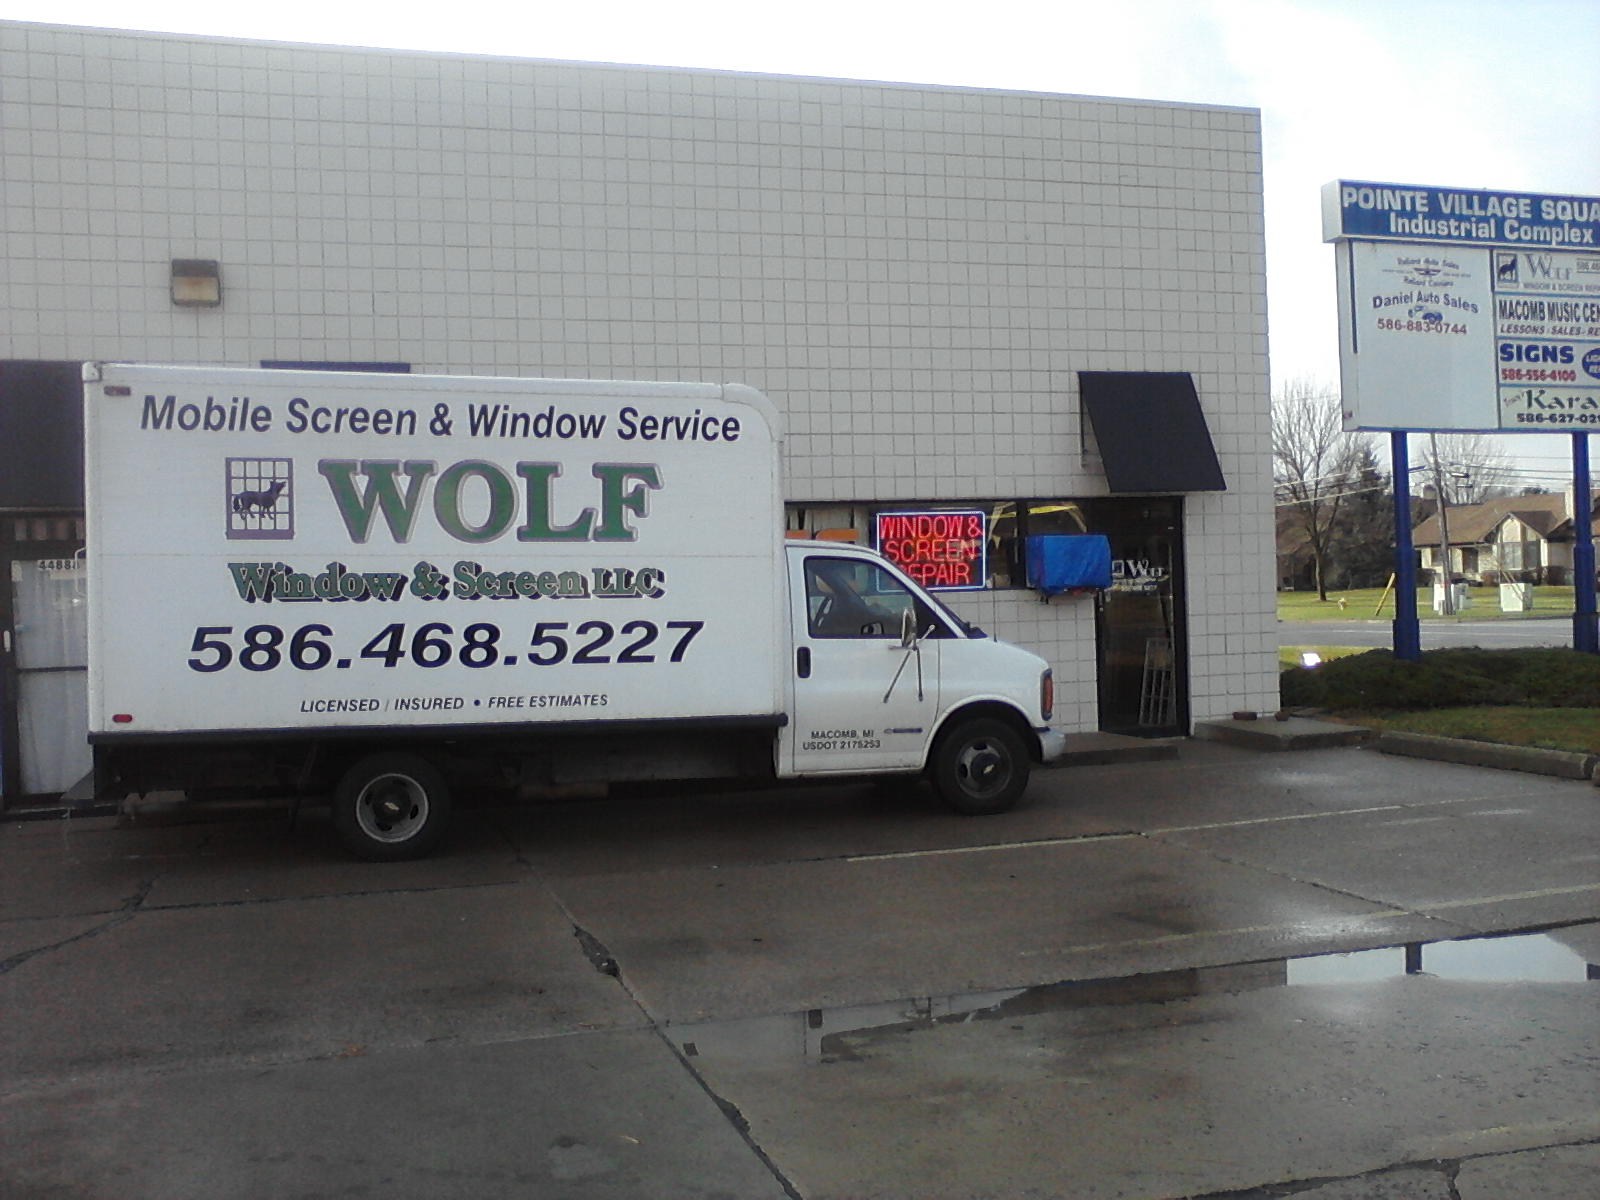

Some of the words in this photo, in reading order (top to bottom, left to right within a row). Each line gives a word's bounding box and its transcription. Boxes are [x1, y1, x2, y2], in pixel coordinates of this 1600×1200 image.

[1342, 187, 1429, 212] POINTE
[1438, 193, 1531, 219] VILLAGE
[1541, 199, 1600, 223] SQUA
[1390, 212, 1495, 239] Industrial
[1504, 219, 1593, 246] Complex
[1372, 291, 1413, 309] Daniel
[1416, 290, 1440, 305] Auto
[1443, 293, 1479, 314] Sales
[1499, 300, 1545, 321] MACOMB
[1547, 301, 1580, 323] MUSIC
[1500, 324, 1545, 335] LESSONS
[1551, 325, 1581, 336] SALES
[1500, 343, 1575, 364] SIGNS
[141, 395, 272, 433] Mobile
[286, 397, 417, 435] Screen
[429, 402, 453, 436] &
[468, 403, 607, 439] Window
[617, 406, 741, 442] Service
[317, 458, 665, 544] WOLF
[880, 515, 963, 540] WINDOW
[968, 515, 984, 538] &
[885, 538, 976, 563] SCREEN
[227, 561, 408, 603] Window
[409, 560, 451, 602] &
[453, 560, 592, 600] Screen
[592, 566, 667, 600] LLC
[187, 620, 705, 673] 586.468.5227
[300, 698, 380, 713] LICENSED
[394, 697, 465, 711] INSURED
[487, 696, 524, 709] FREE
[529, 694, 609, 708] ESTIMATES
[802, 740, 838, 751] USDOT
[862, 729, 874, 738] MI
